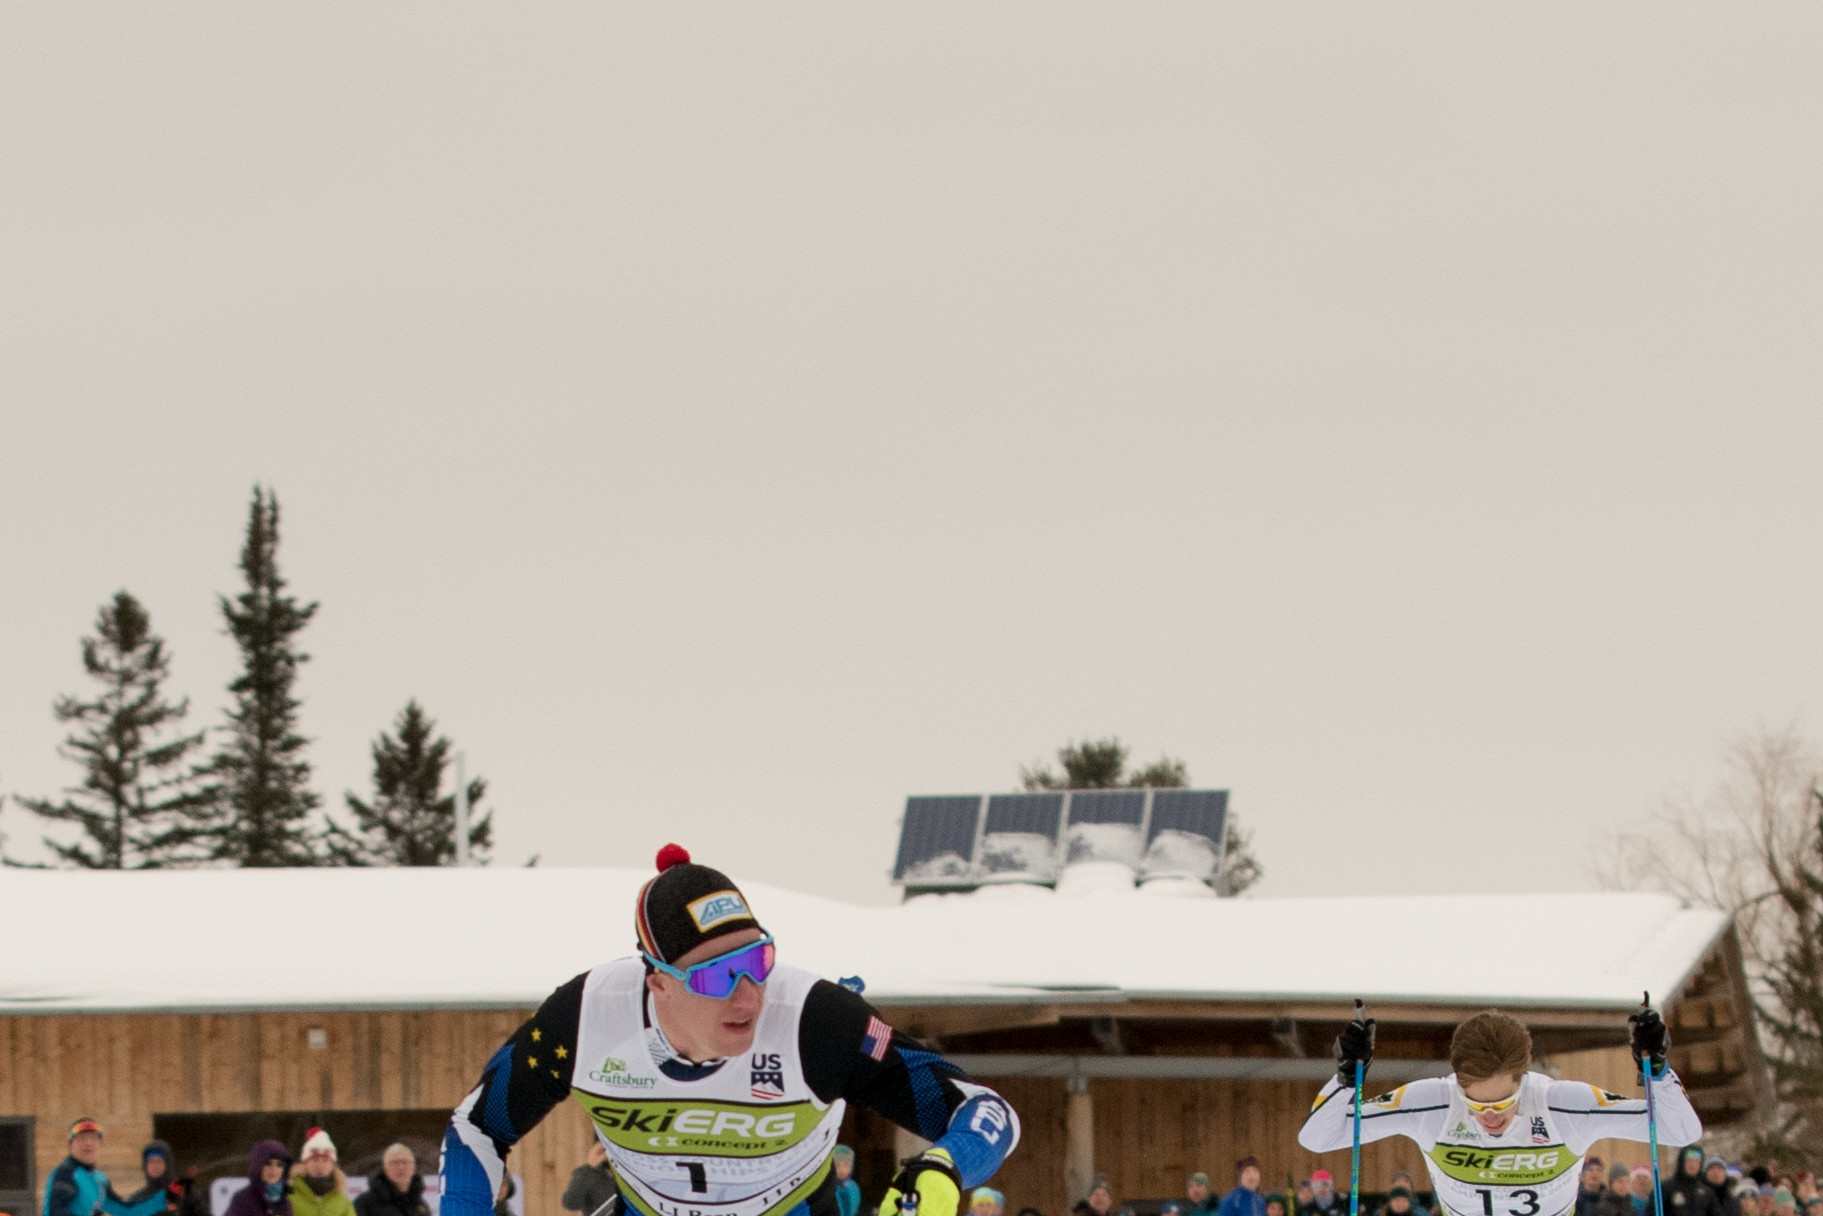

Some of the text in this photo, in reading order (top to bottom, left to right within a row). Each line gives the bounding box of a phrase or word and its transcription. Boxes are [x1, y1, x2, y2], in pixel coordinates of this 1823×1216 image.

[751, 1052, 782, 1071] US
[589, 1070, 658, 1089] Craftsbury
[590, 1106, 797, 1139] SkiERG
[1530, 1116, 1544, 1127] US
[682, 1139, 767, 1150] concept
[1442, 1151, 1560, 1171] SkiERG
[675, 1161, 708, 1194] 1
